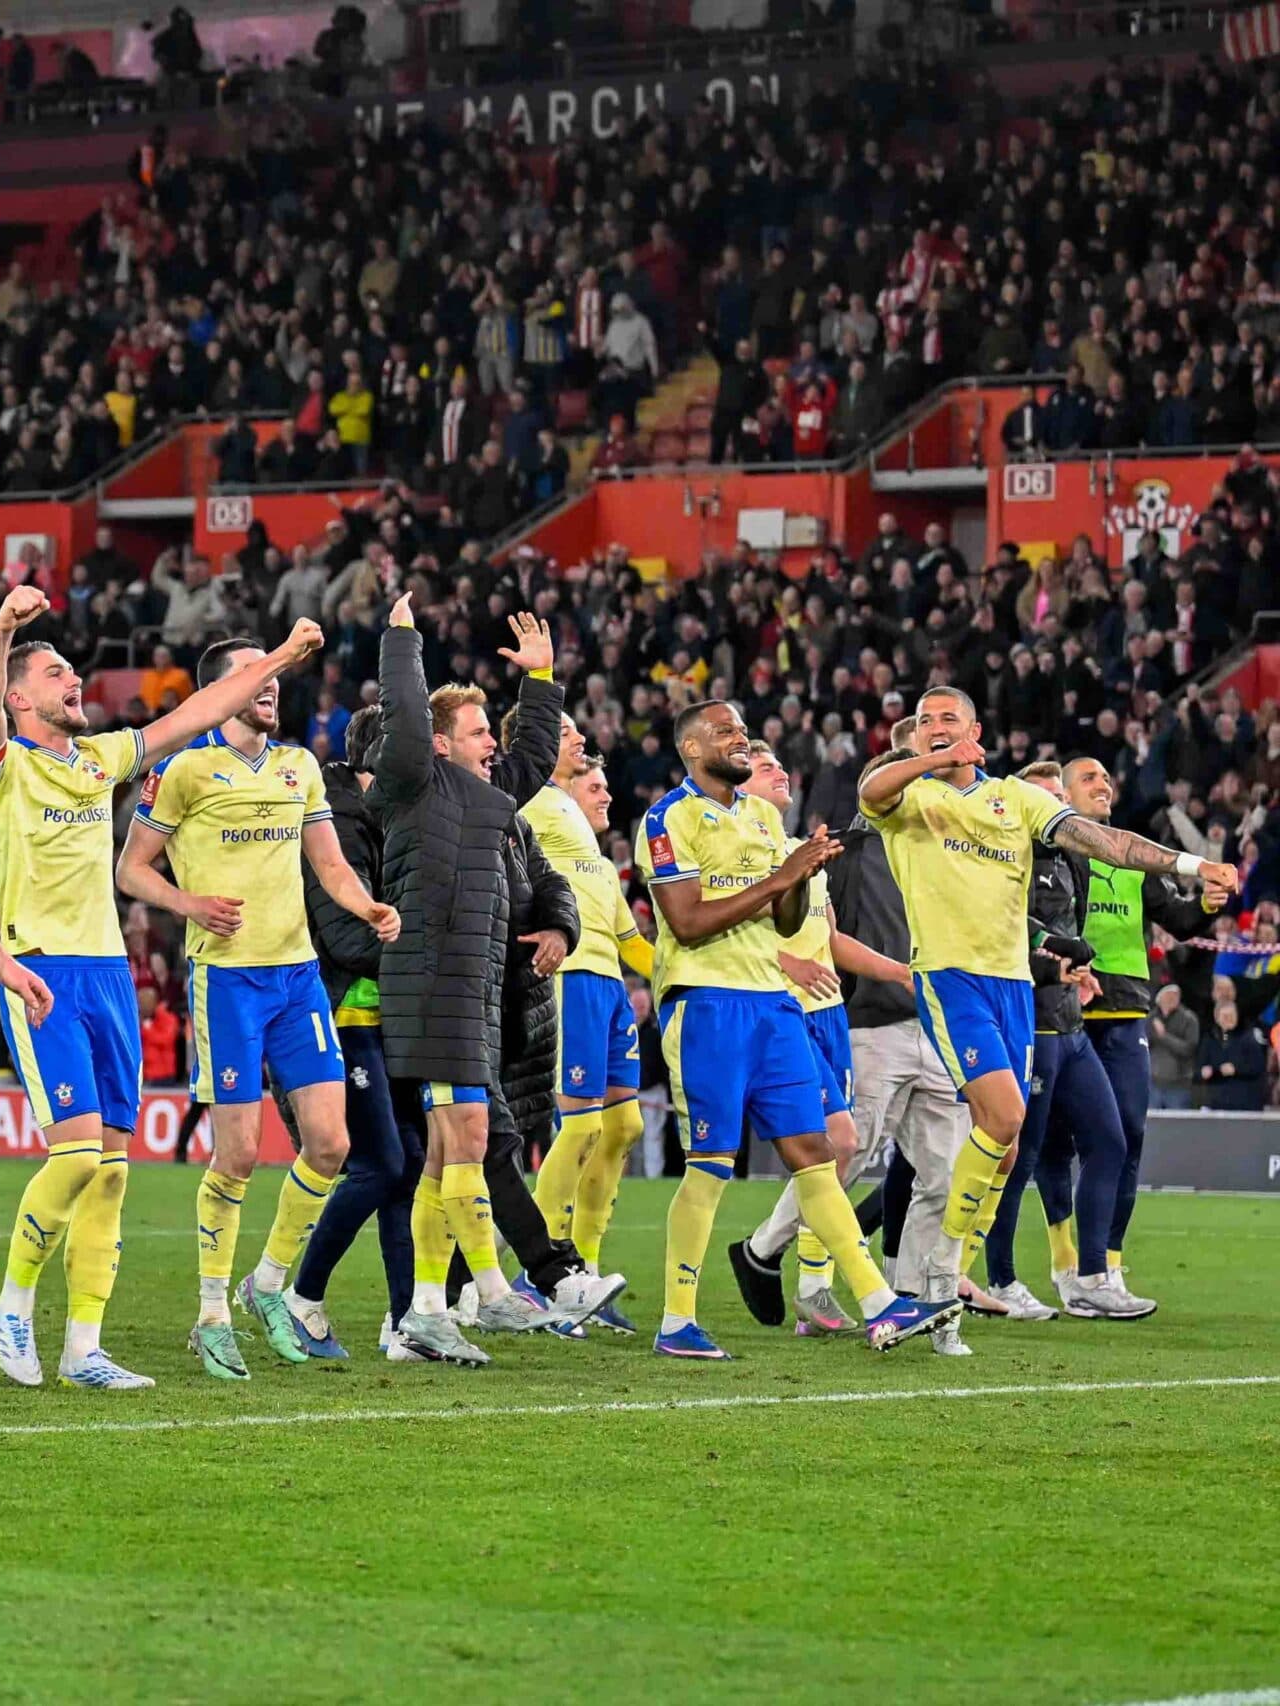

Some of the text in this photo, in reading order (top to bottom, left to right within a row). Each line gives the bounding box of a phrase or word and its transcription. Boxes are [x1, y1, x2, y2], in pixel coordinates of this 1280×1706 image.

[1012, 470, 1047, 495] D6
[214, 500, 245, 522] D5
[221, 828, 250, 843] P&O
[943, 837, 969, 855] P&O
[709, 874, 734, 888] P&O
